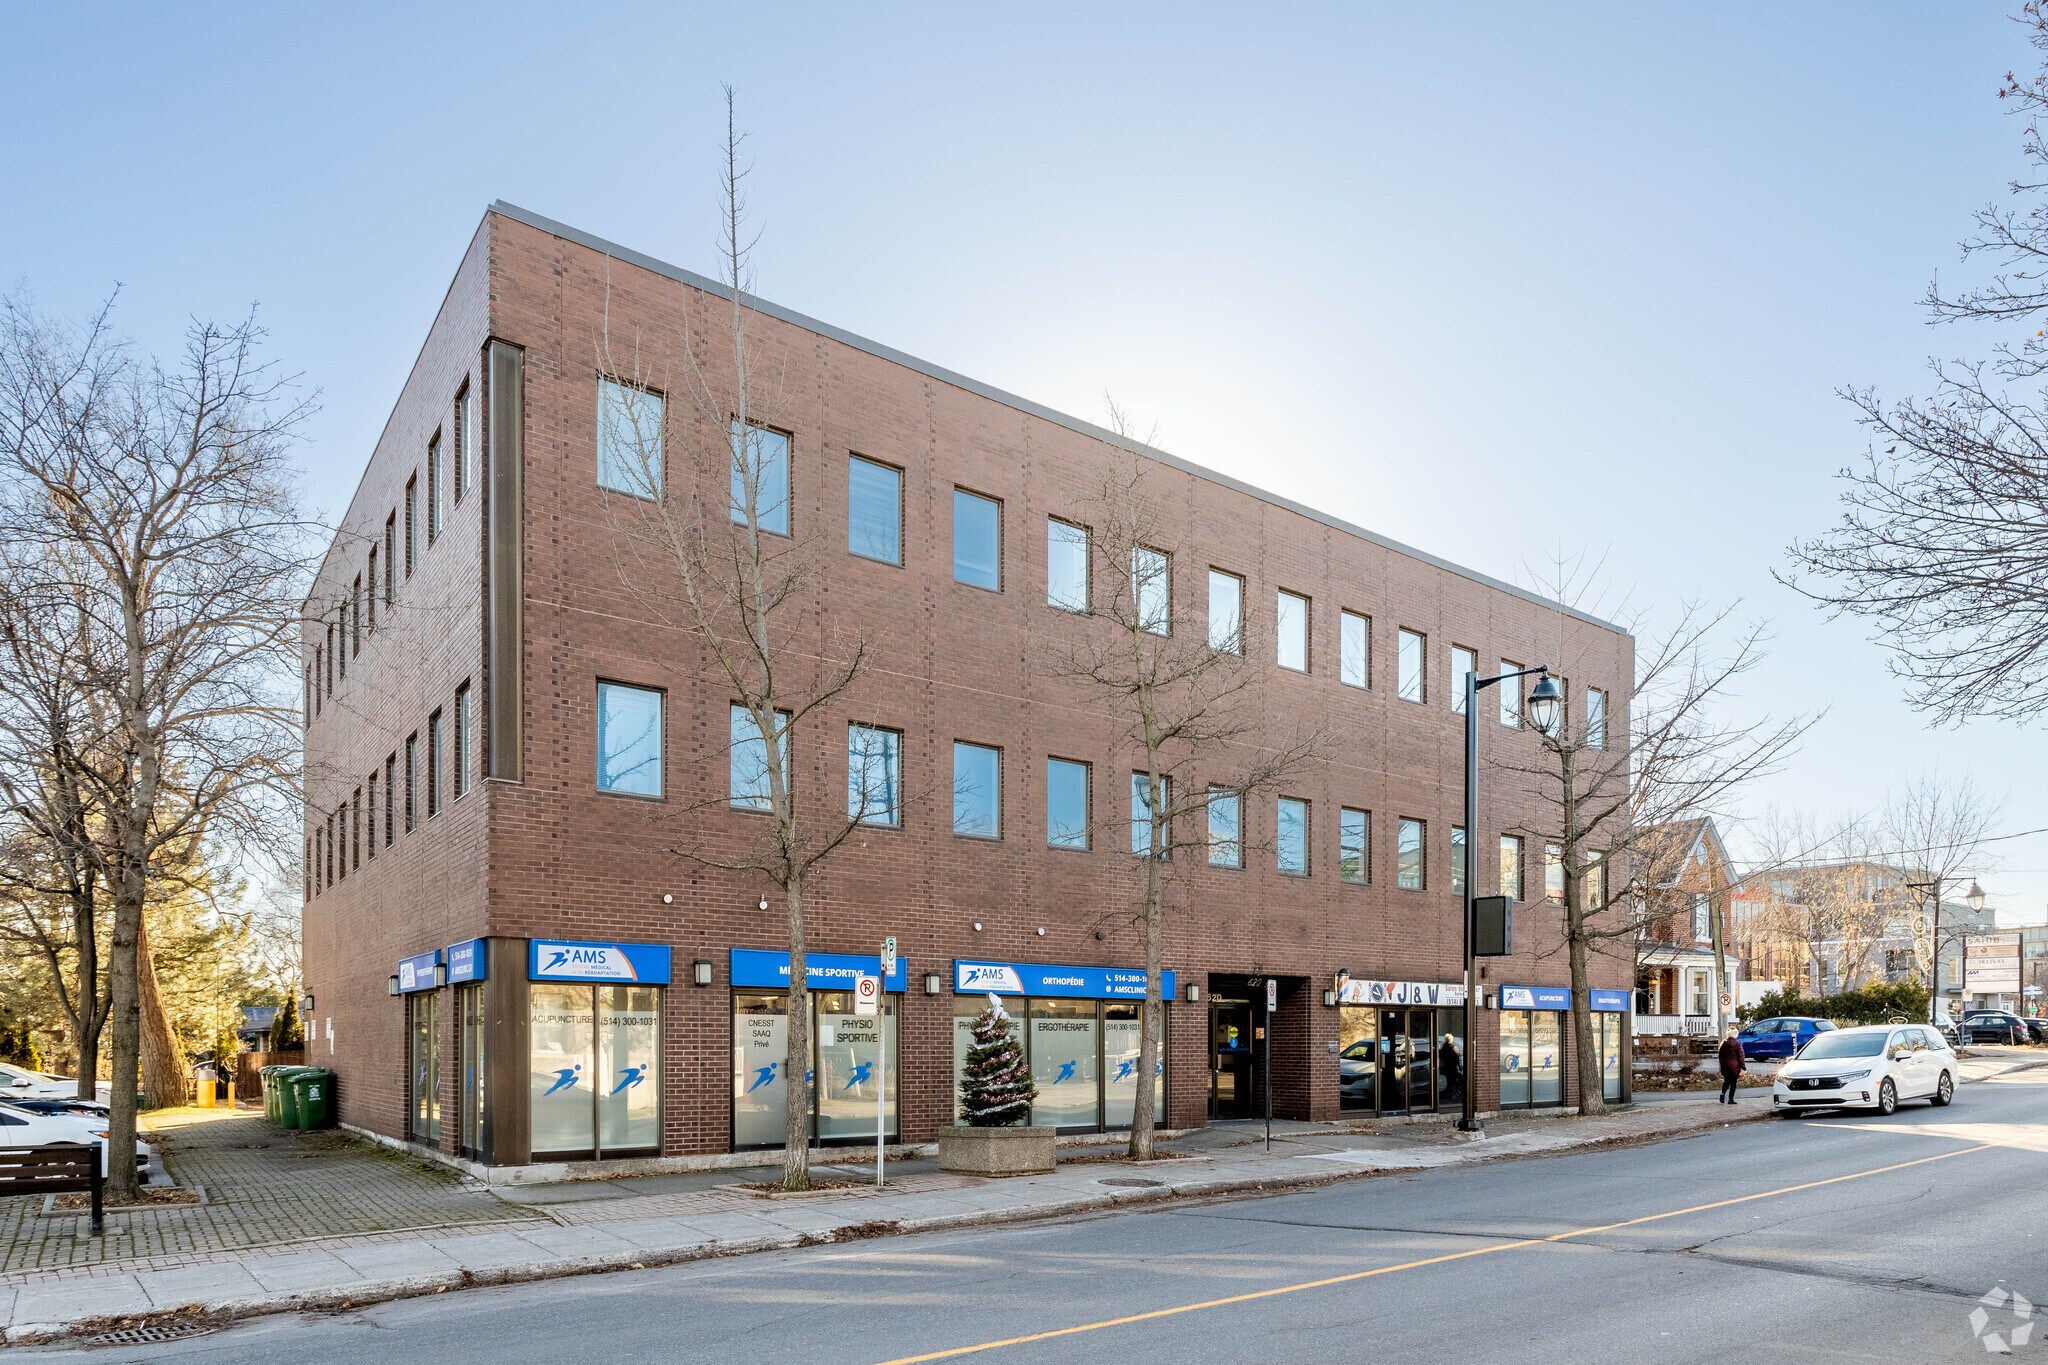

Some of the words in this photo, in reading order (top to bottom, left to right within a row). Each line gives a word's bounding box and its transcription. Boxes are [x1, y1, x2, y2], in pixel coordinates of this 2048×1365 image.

[572, 950, 606, 964] AMS
[825, 968, 864, 978] SPORTIVE
[982, 968, 1003, 980] AMS
[1043, 977, 1084, 986] ORTHOPÉDIE
[1114, 975, 1146, 983] 514-300-1
[1398, 983, 1406, 1003] J
[1414, 986, 1422, 1003] &
[1428, 985, 1439, 1004] W
[1514, 990, 1525, 999] AMS
[532, 1015, 592, 1024] ACUPUNCTURE
[600, 1017, 620, 1027] (514)
[622, 1017, 657, 1026] 300-1031
[842, 1020, 873, 1028] PHYSIO
[1038, 1022, 1090, 1031] ERGOTHÉRAPIE
[1106, 1023, 1118, 1032] (514)
[1119, 1023, 1140, 1031] 300-1031
[752, 1030, 771, 1038] SAAQ
[837, 1033, 878, 1043] SPORTIVE
